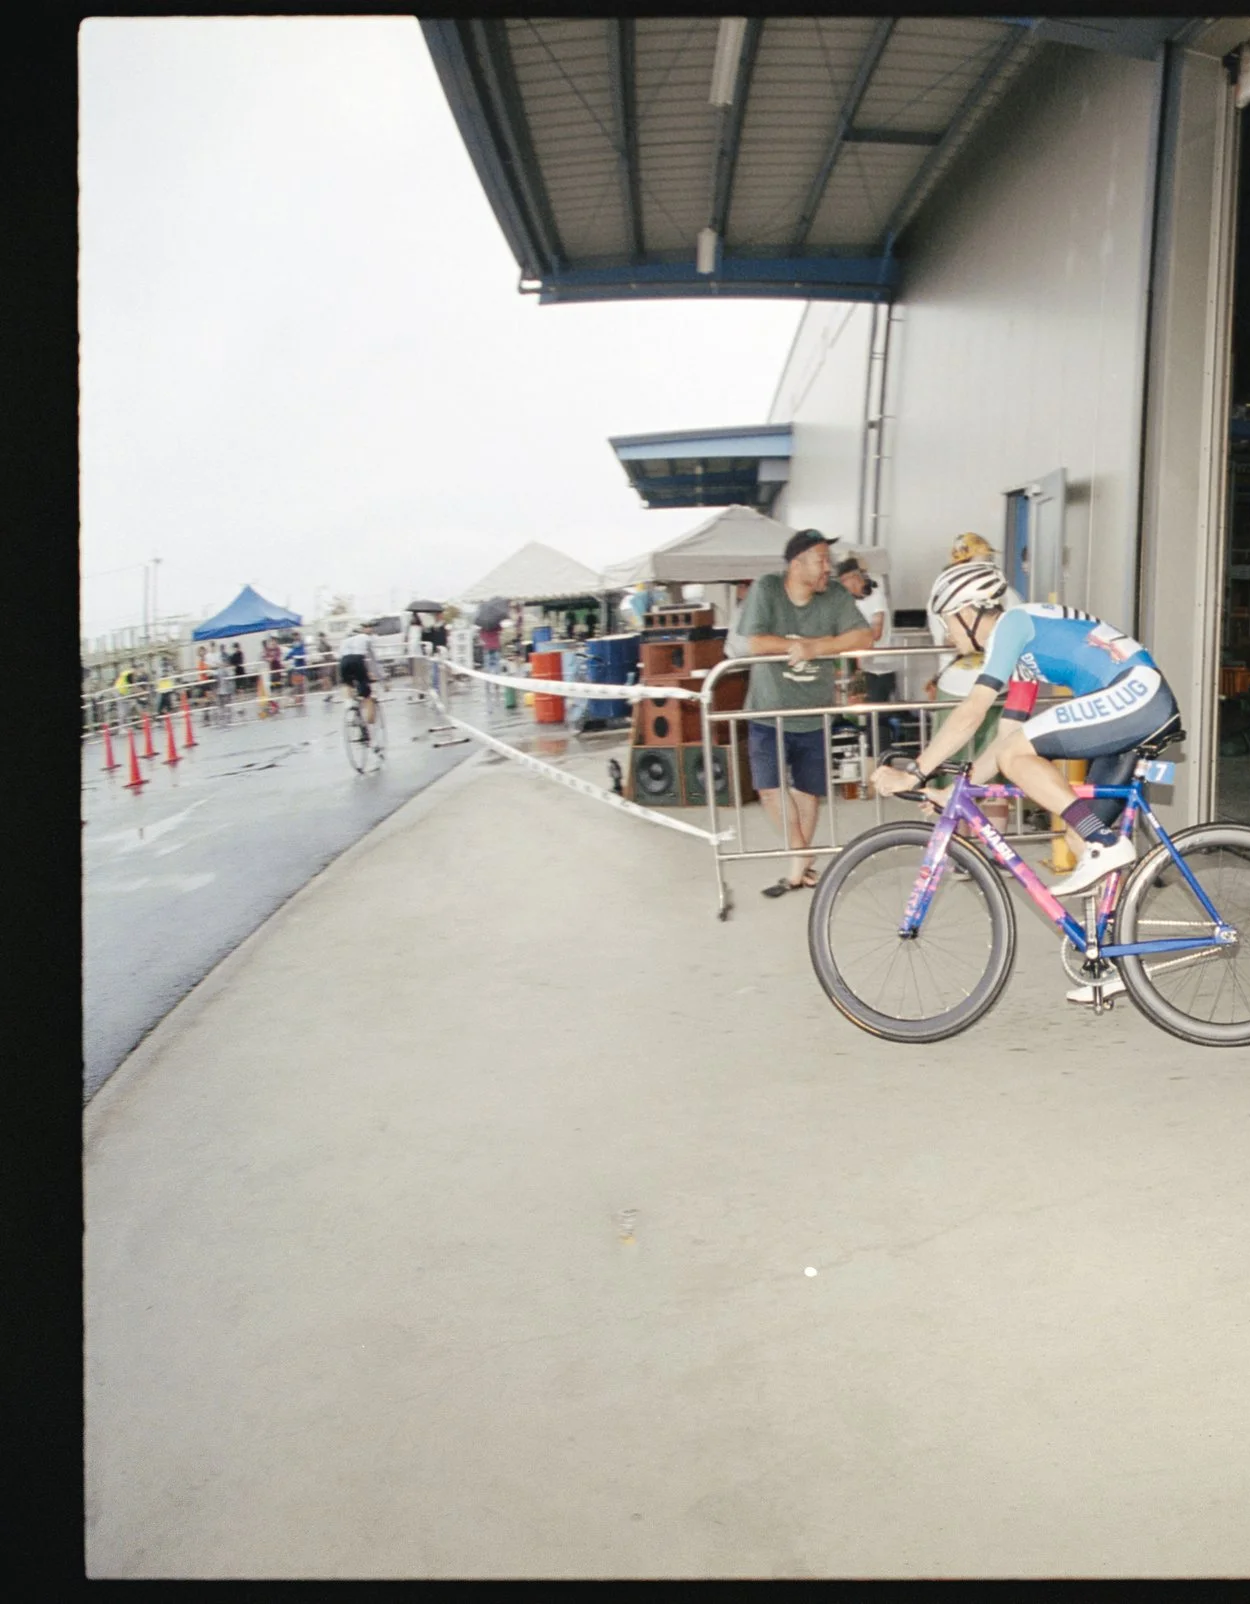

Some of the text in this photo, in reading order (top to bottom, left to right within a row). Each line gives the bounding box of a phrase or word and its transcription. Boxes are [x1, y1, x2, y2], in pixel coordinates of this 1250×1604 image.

[1055, 679, 1148, 724] BLUE LUG
[1155, 763, 1168, 782] 7
[982, 823, 1016, 861] MASH
